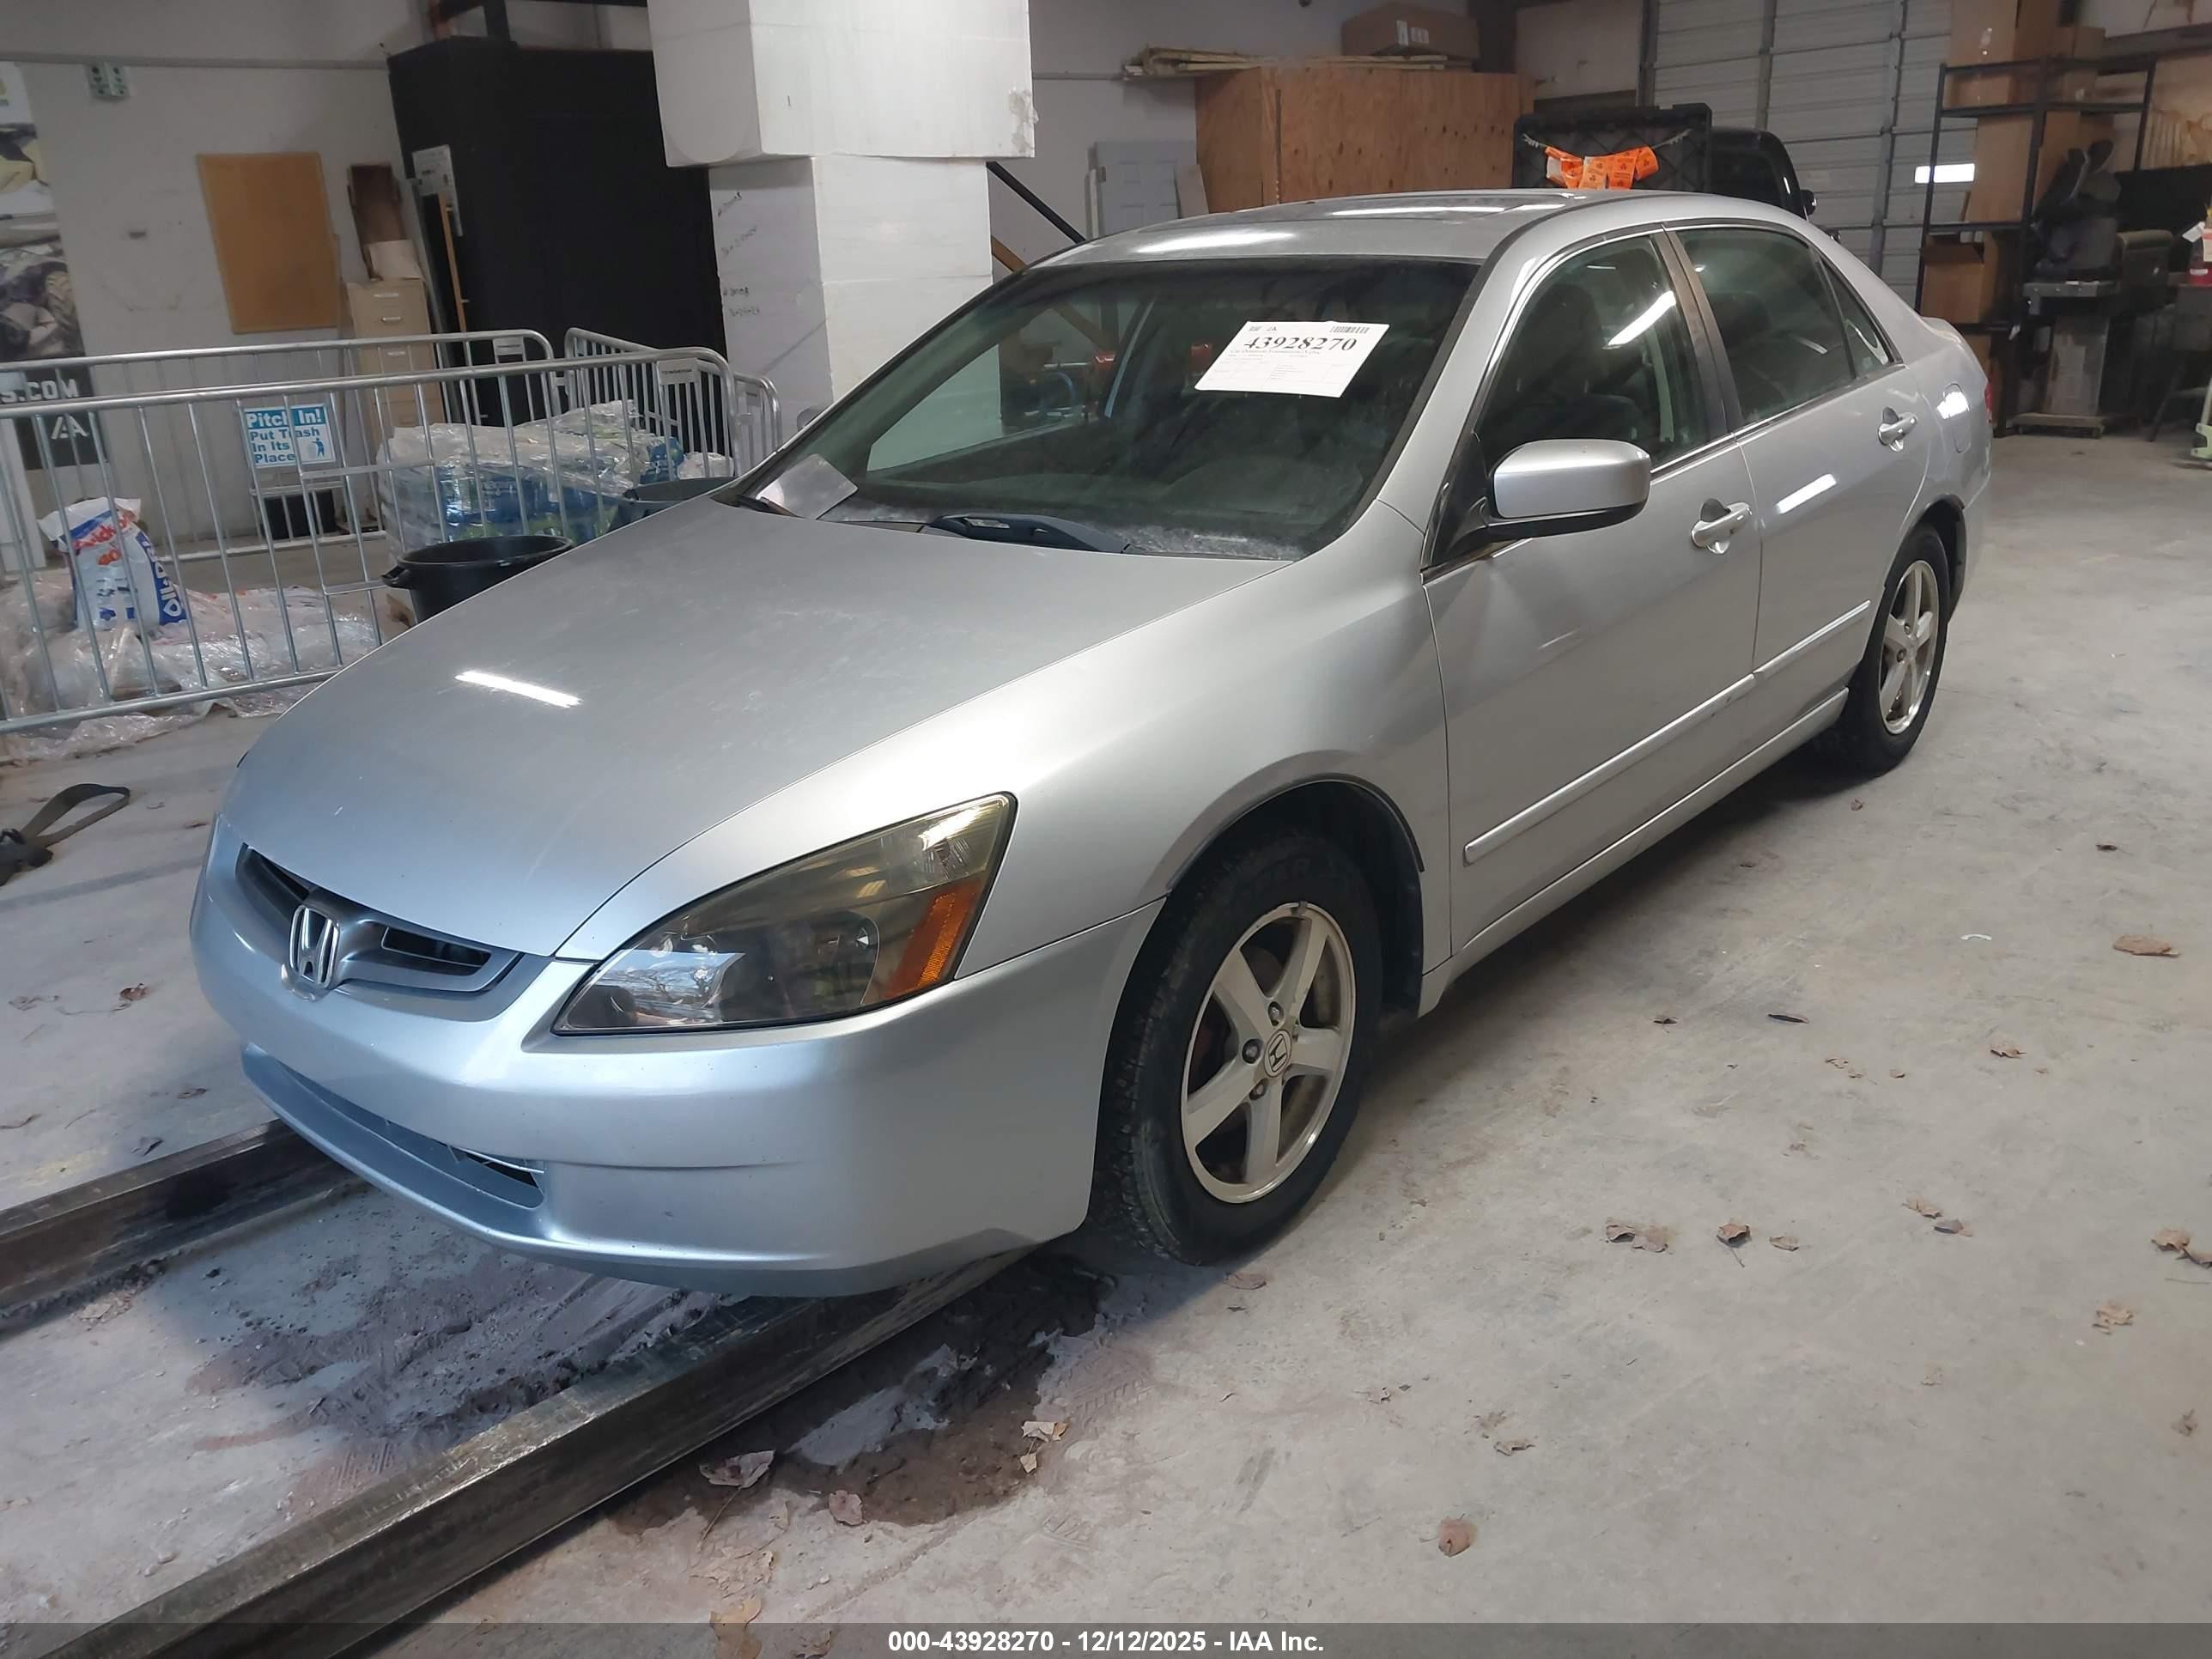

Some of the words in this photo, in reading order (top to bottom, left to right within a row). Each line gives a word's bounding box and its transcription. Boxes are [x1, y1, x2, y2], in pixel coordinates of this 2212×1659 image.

[1243, 337, 1358, 351] 43928270
[299, 408, 323, 424] In!
[250, 430, 275, 441] Put
[252, 442, 266, 453] In
[270, 441, 290, 451] Its
[253, 453, 296, 464] Place
